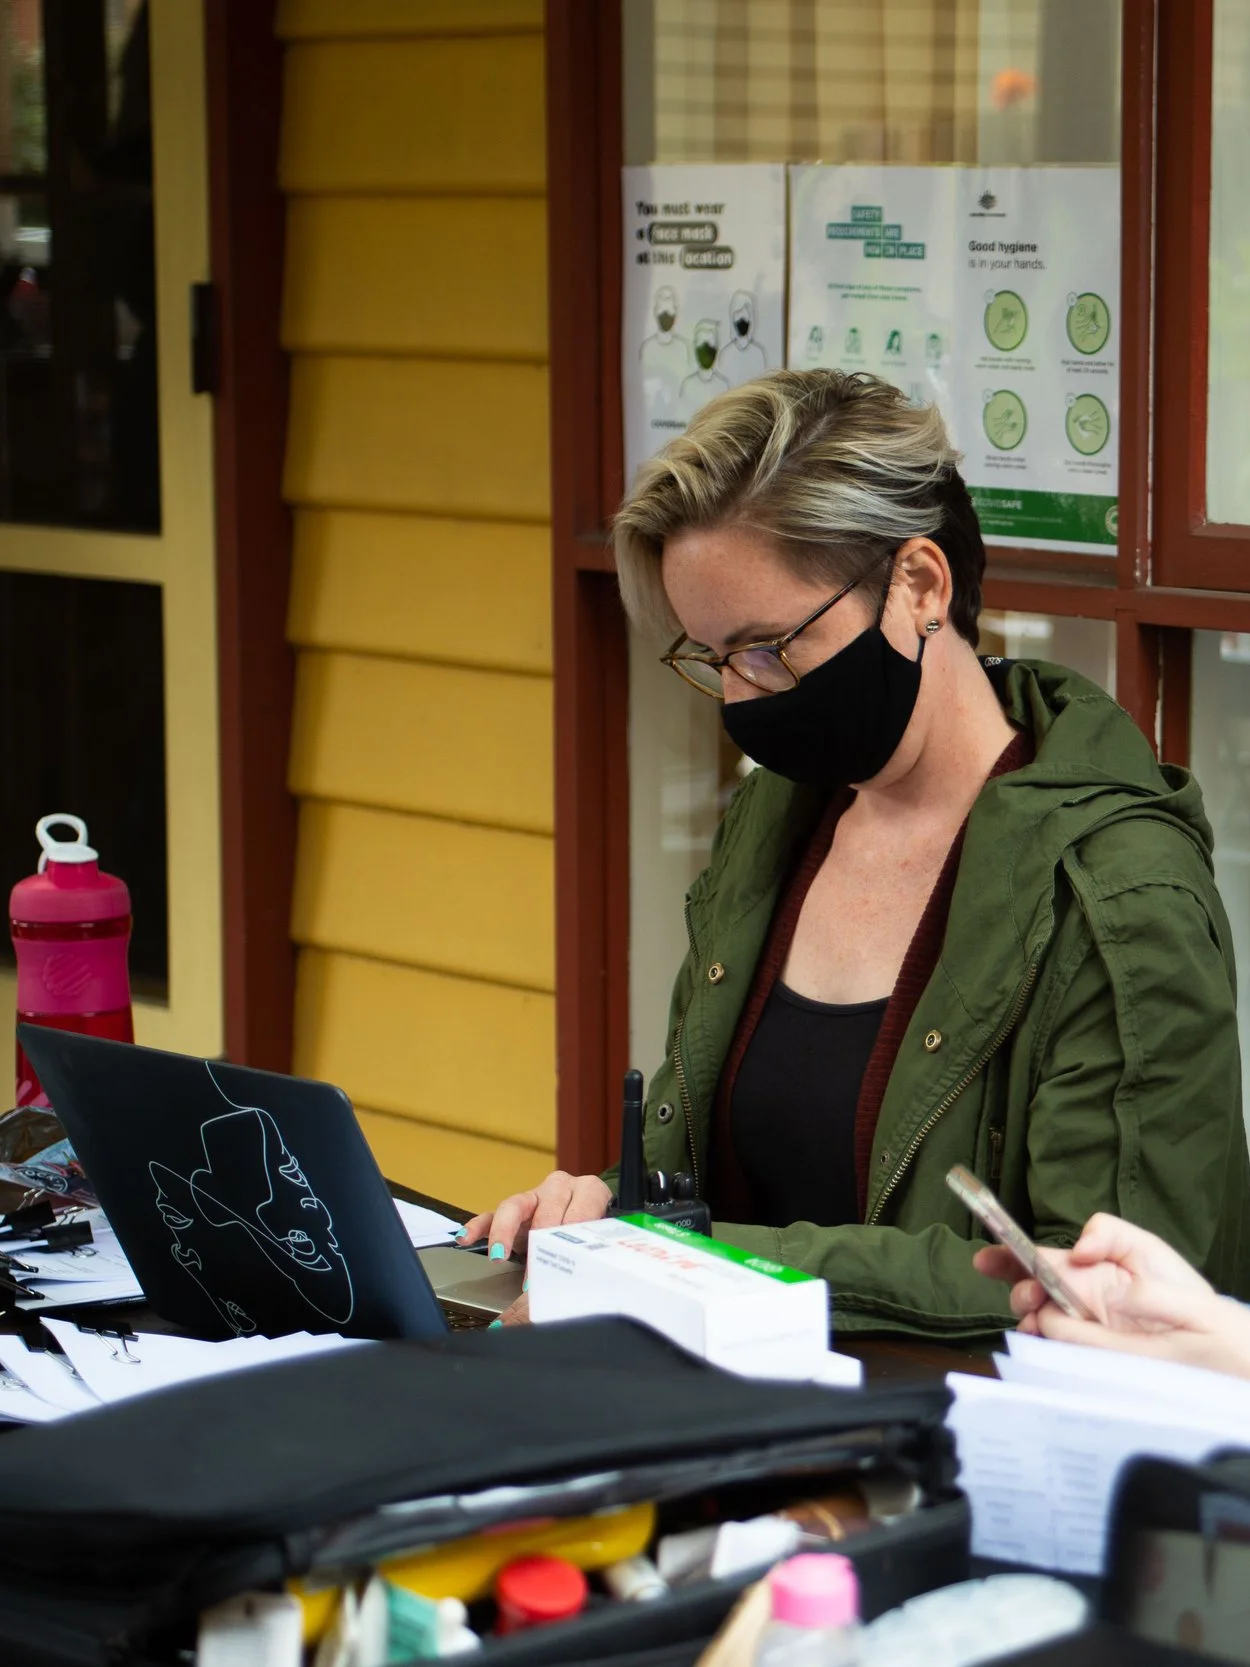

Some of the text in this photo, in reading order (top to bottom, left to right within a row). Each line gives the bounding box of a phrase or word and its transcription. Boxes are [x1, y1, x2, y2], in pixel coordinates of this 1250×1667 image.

[635, 201, 724, 216] You must wear
[968, 240, 1037, 254] Good hygiene
[652, 250, 675, 264] this
[681, 250, 732, 267] ocation
[968, 257, 976, 268] is
[979, 257, 987, 268] in
[990, 259, 1012, 270] your
